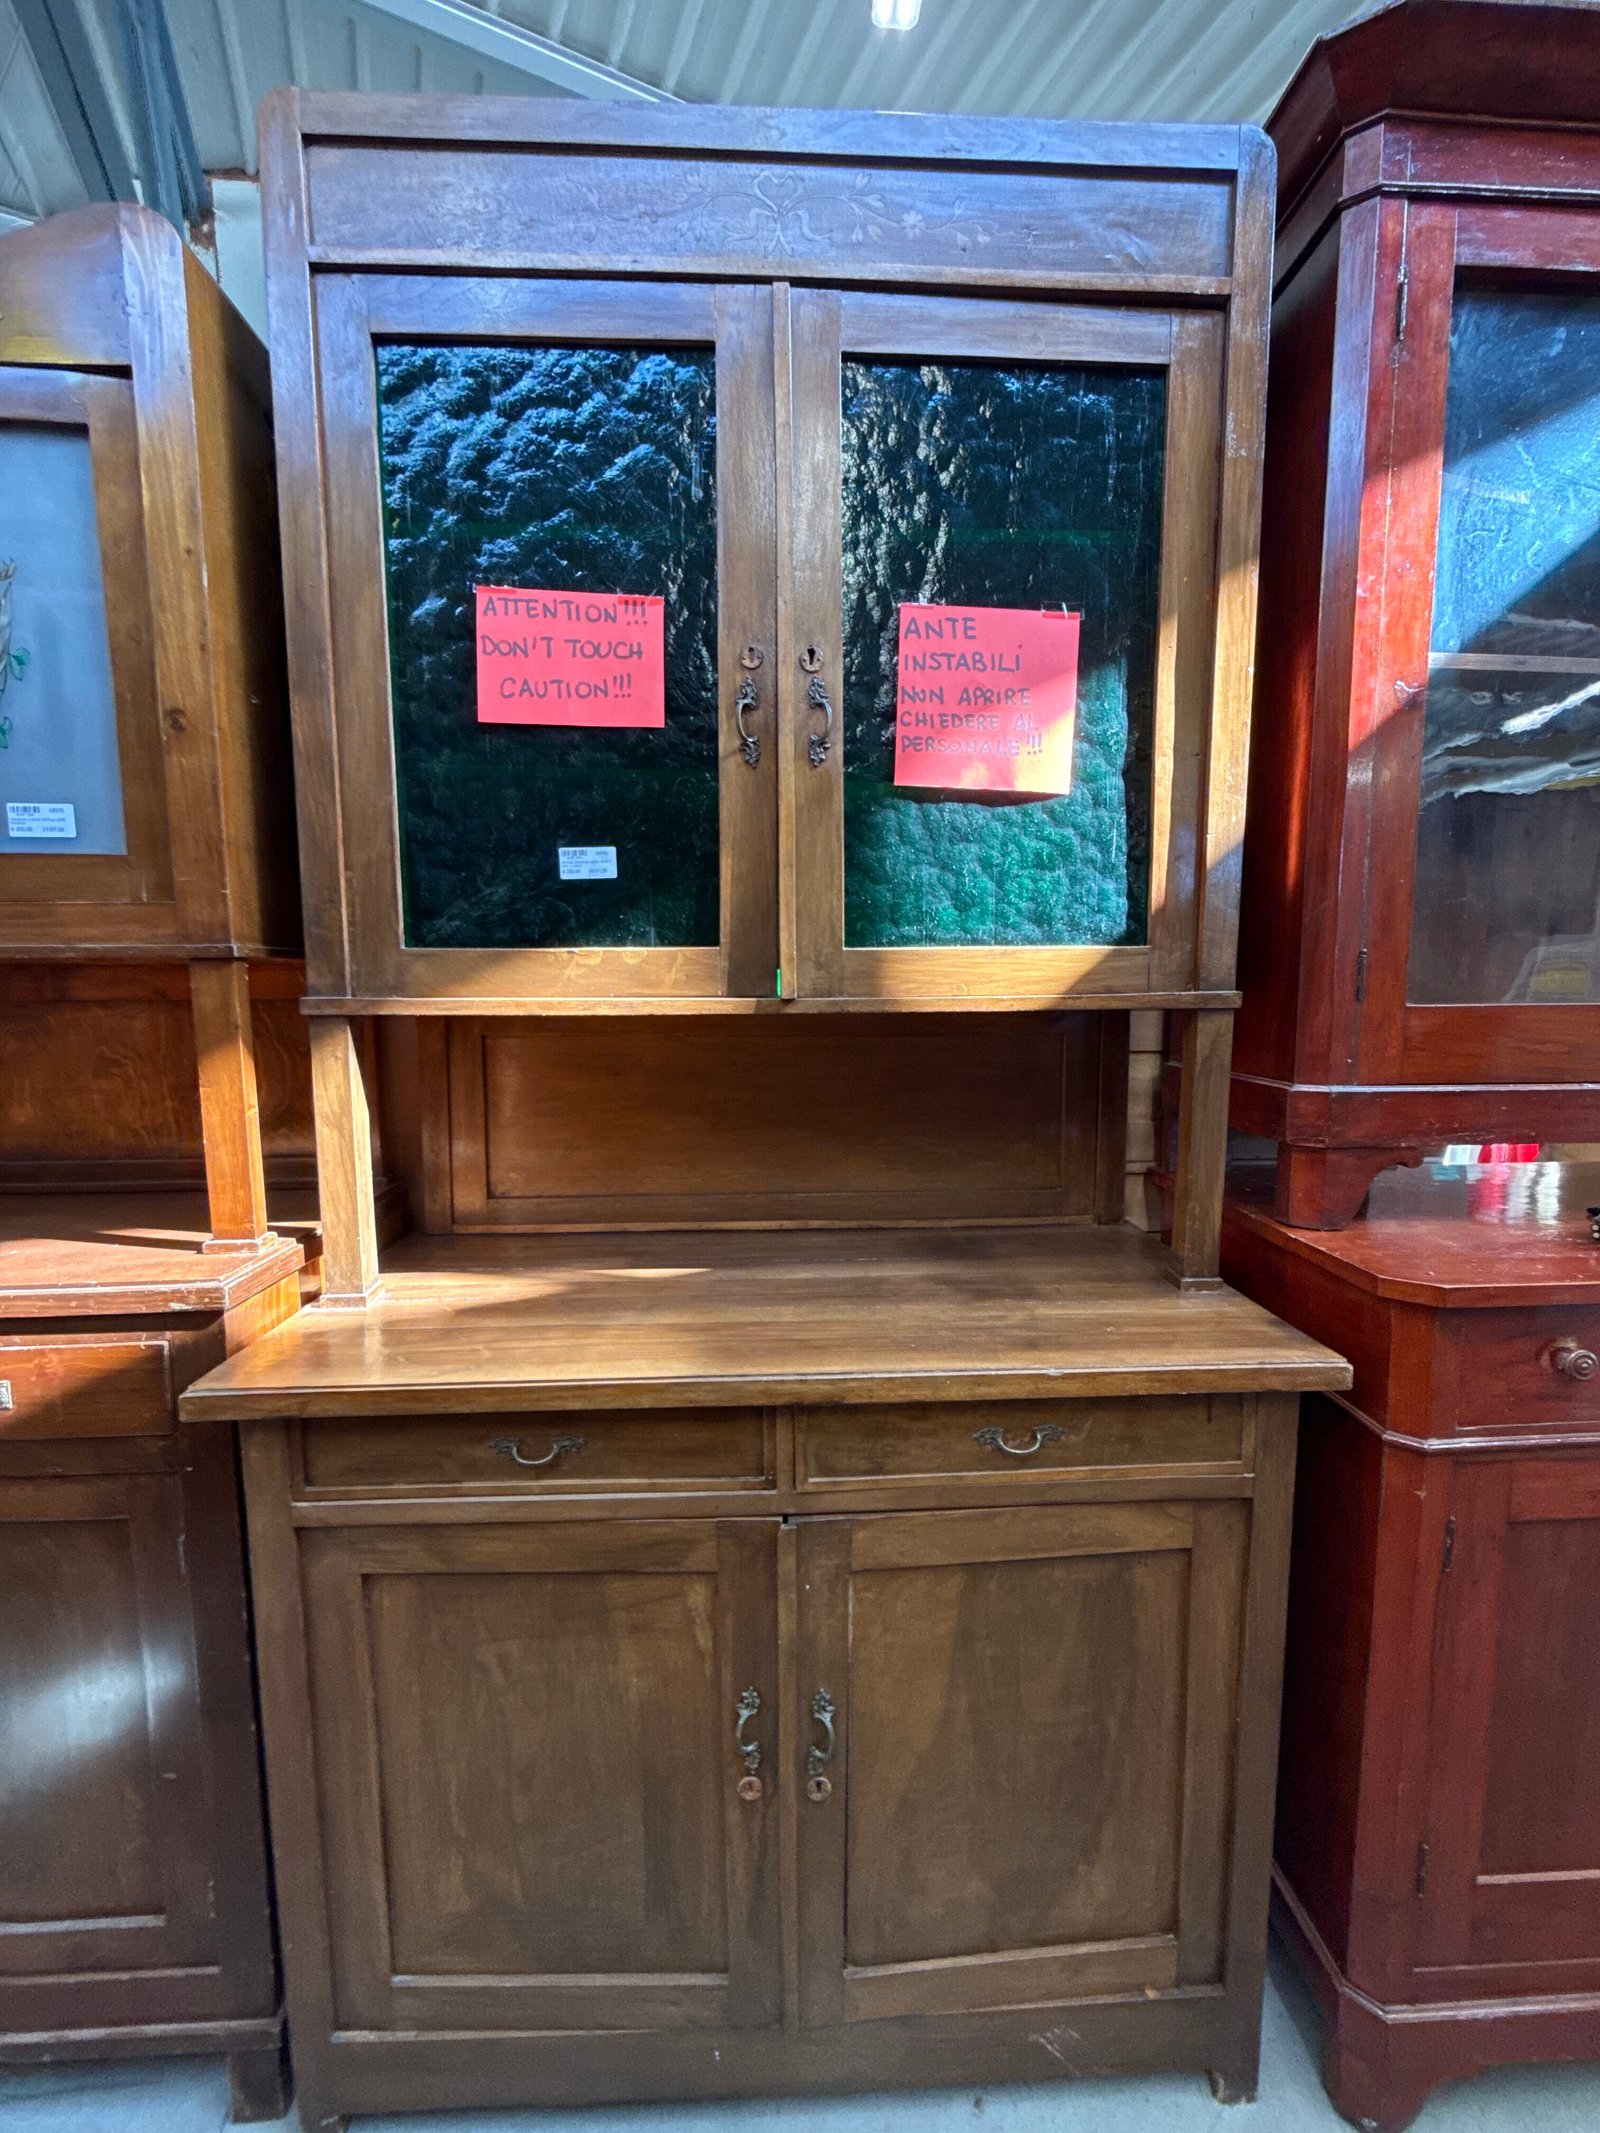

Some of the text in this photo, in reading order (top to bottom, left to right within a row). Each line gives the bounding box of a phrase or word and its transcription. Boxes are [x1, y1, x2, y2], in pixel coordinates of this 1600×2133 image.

[483, 596, 648, 626] ATTENTION!!!
[904, 616, 977, 640] ANTE
[480, 635, 643, 660] DON'T TOUCH
[500, 672, 633, 699] CAUTION!!!
[901, 685, 1032, 707] NON APRIRE
[900, 711, 1038, 731] CHIEDERE AL
[901, 733, 1043, 757] PERSONALE!!!
